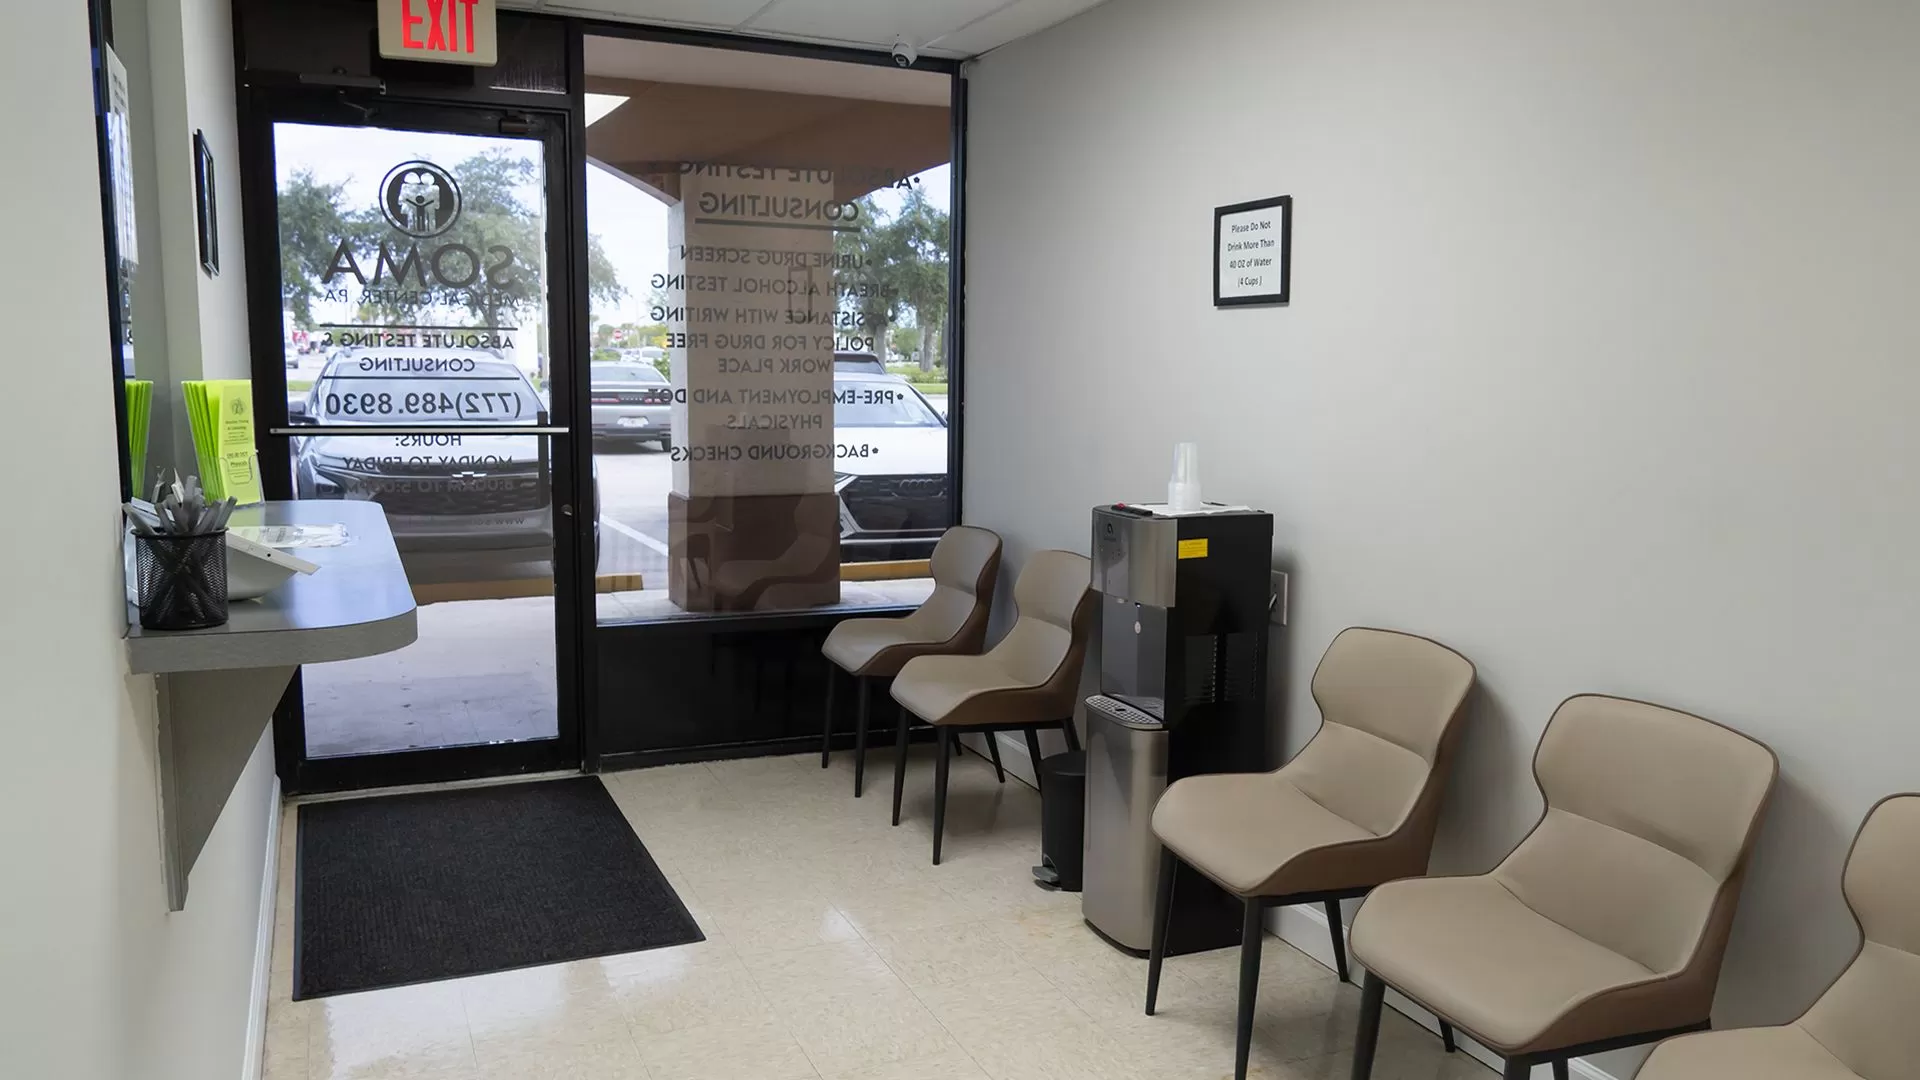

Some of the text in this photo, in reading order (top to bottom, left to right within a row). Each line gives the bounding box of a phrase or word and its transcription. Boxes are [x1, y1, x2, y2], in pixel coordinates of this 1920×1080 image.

[402, 0, 478, 53] EXIT
[1231, 220, 1271, 233] Please Do Not
[1227, 239, 1275, 252] Drink More Than
[1246, 259, 1252, 268] of
[1253, 258, 1272, 267] Water
[1244, 276, 1258, 286] Cups
